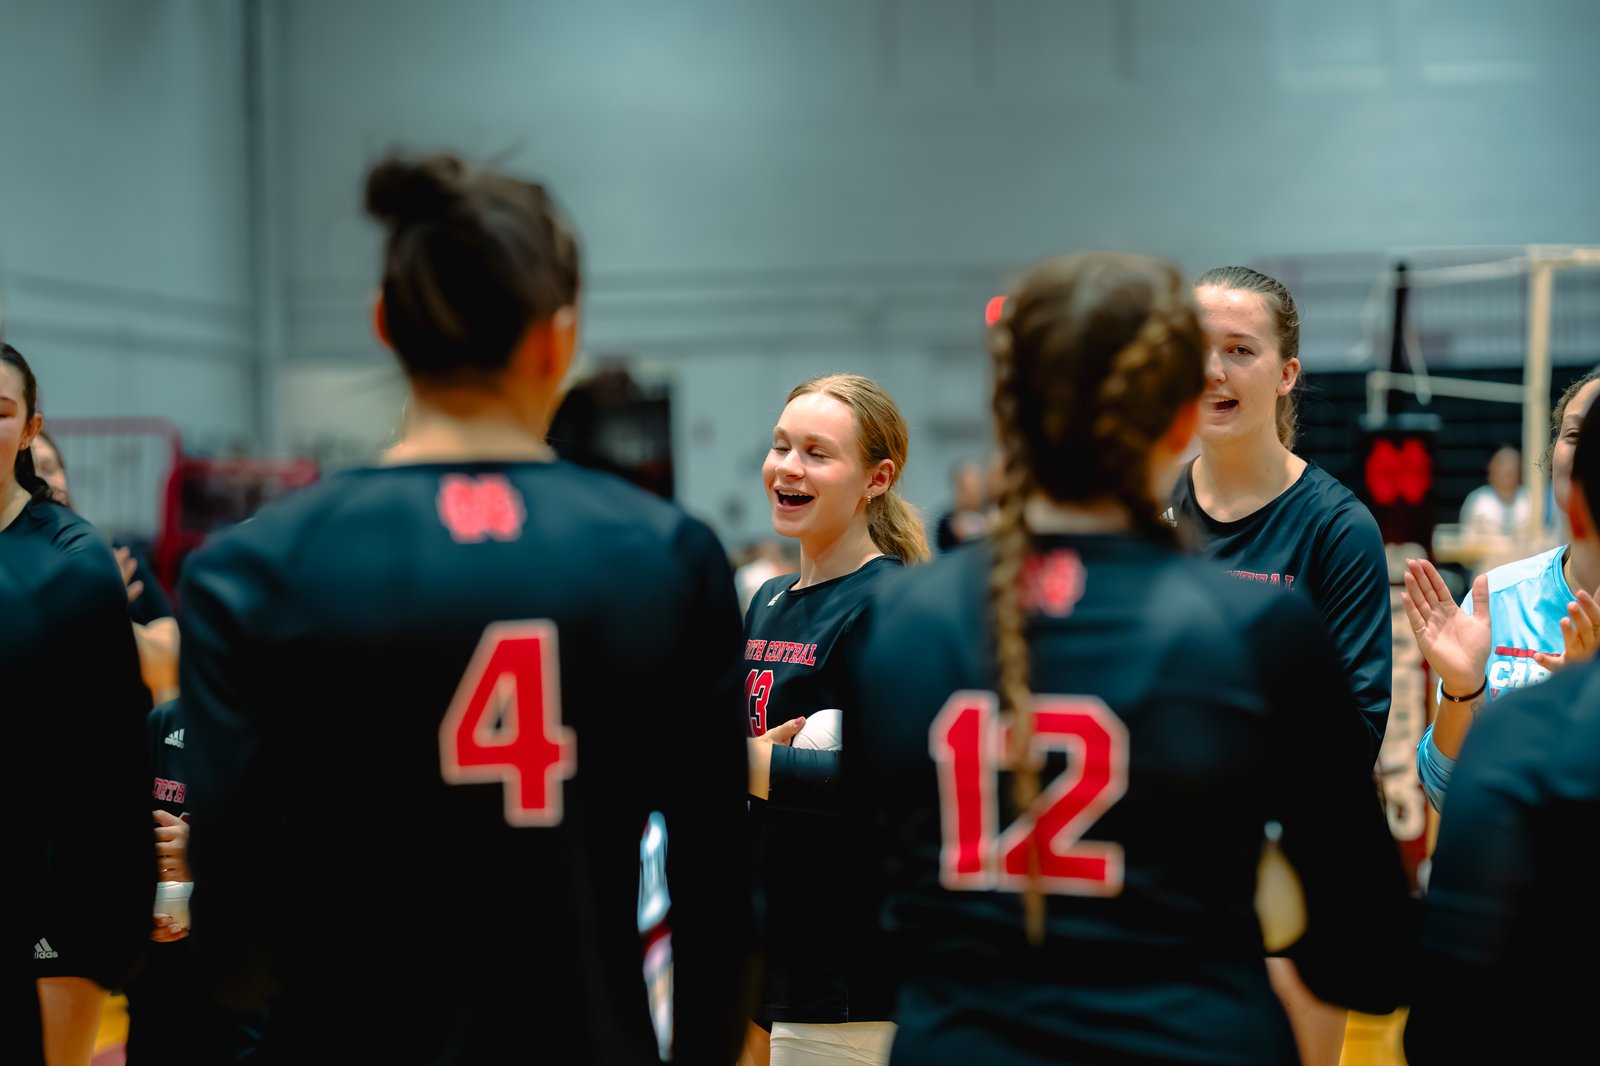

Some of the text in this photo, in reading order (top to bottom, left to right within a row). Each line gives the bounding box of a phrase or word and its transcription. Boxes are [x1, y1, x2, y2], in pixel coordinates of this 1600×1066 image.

[764, 641, 817, 666] CENTRAL
[438, 618, 578, 828] 4
[744, 669, 774, 738] 13
[153, 778, 187, 804] ORTH
[928, 690, 1130, 898] 12
